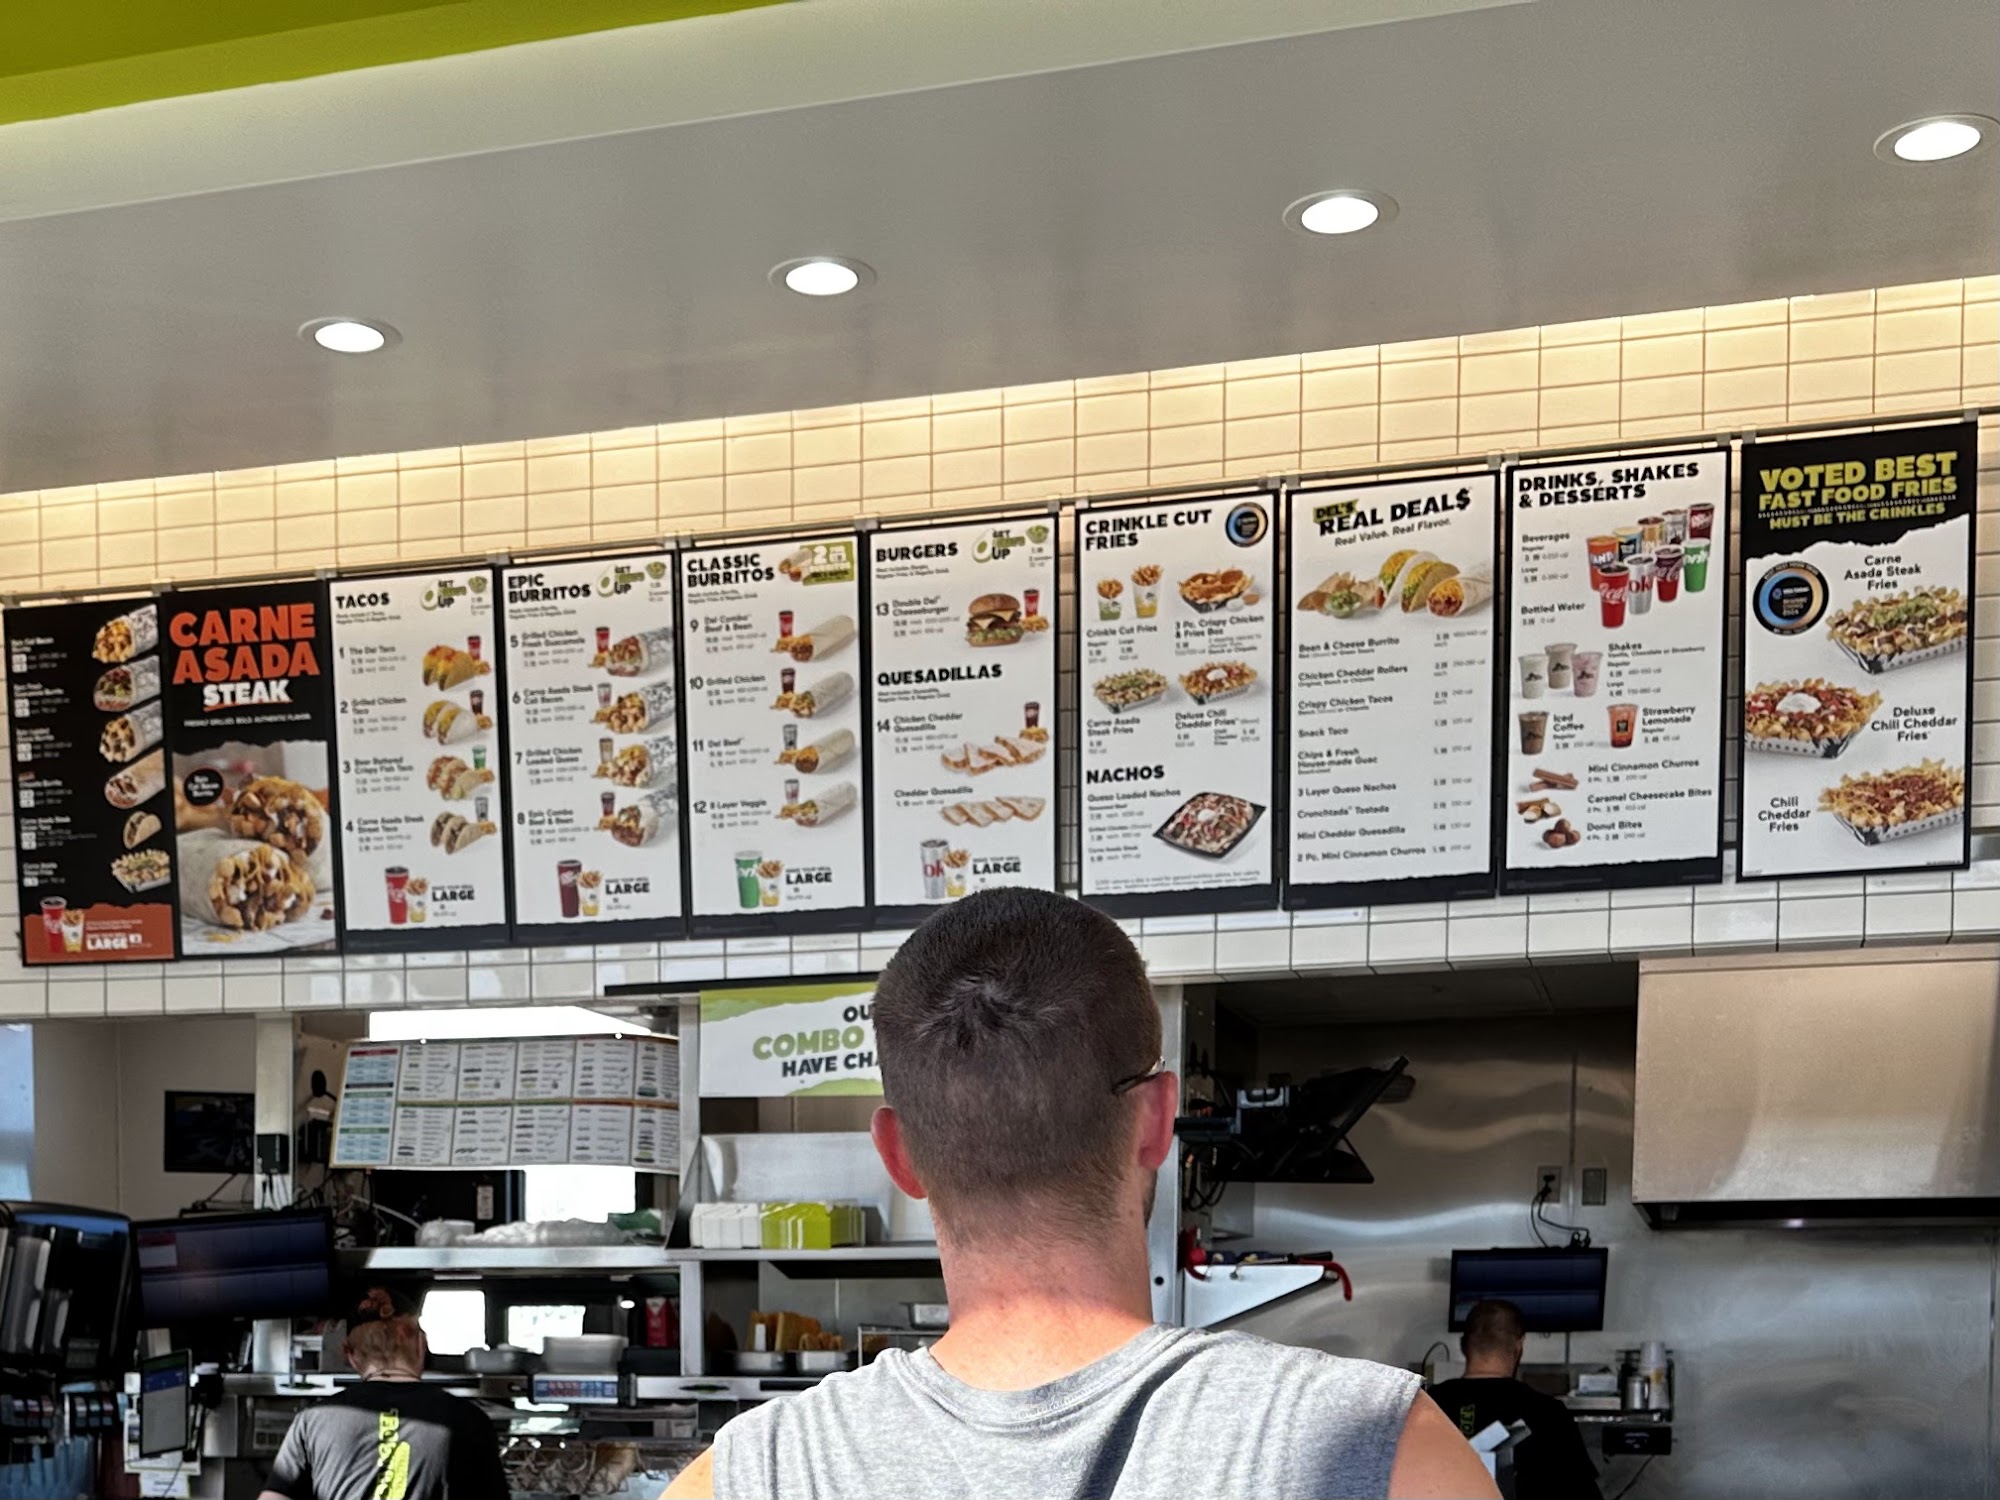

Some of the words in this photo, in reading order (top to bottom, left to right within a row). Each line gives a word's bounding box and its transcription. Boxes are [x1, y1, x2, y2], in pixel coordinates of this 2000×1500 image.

[1518, 470, 1604, 492] DRINKS,
[1611, 462, 1699, 484] SHAKES
[1760, 461, 1866, 492] VOTED
[1875, 451, 1958, 481] BEST
[1519, 493, 1533, 508] &
[1539, 484, 1646, 507] DESSERTS
[1759, 489, 1816, 512] FAST
[1821, 483, 1886, 505] FOOD
[1892, 476, 1958, 499] FRIES
[1316, 500, 1356, 519] DEL'S
[1320, 508, 1384, 536] REAL
[1390, 487, 1471, 521] DEAL$
[1770, 514, 1811, 530] MUST
[1813, 512, 1834, 526] BE
[1837, 509, 1866, 523] THE
[1869, 502, 1946, 521] CRINKLES
[1085, 514, 1168, 535] CRINKLE
[1174, 509, 1212, 526] CUT
[1334, 537, 1357, 547] Real
[1359, 531, 1389, 542] Value.
[1392, 523, 1415, 535] Real
[1417, 518, 1451, 531] Flavor.
[1522, 532, 1570, 543] Beverages
[1086, 533, 1138, 551] FRIES
[813, 545, 828, 565] 2
[876, 542, 959, 562] BURGERS
[992, 547, 1010, 560] UP
[687, 554, 761, 572] CLASSIC
[1864, 555, 1902, 566] Carne
[688, 567, 775, 588] BURRITOS
[1844, 568, 1883, 581] Asada
[1886, 564, 1922, 576] Steak
[507, 574, 545, 589] EPIC
[1867, 579, 1898, 591] Fries
[508, 584, 592, 604] BURRITOS
[615, 584, 632, 595] UP
[336, 592, 390, 609] TACOS
[438, 597, 455, 608] UP
[876, 603, 889, 616] 13
[893, 597, 921, 607] Double
[893, 606, 949, 617] Cheeseburger
[1521, 604, 1555, 615] Bottled
[1557, 602, 1586, 612] Water
[169, 603, 316, 648] CARNE
[690, 620, 699, 632] 9
[1199, 619, 1227, 628] Crispy
[1230, 615, 1264, 625] Chicken
[510, 635, 519, 648] 5
[522, 632, 546, 641] Grilled
[548, 629, 578, 639] Chicken
[1087, 627, 1117, 638] Crinkle
[1119, 627, 1134, 635] Cut
[1137, 625, 1158, 634] Fries
[1184, 629, 1205, 638] Fries
[1208, 628, 1223, 636] Box
[339, 648, 345, 658] 1
[379, 646, 396, 654] Taco
[1299, 644, 1321, 653] Bean
[1332, 640, 1365, 650] Cheese
[1368, 637, 1399, 647] Burrito
[1608, 642, 1642, 651] Shakes
[173, 641, 320, 685] ASADA
[877, 664, 1002, 686] QUESADILLAS
[1298, 672, 1334, 681] Chicken
[1336, 668, 1374, 678] Cheddar
[1377, 665, 1408, 674] Rollers
[690, 676, 704, 690] 10
[706, 676, 732, 686] Grilled
[734, 675, 766, 684] Chicken
[203, 679, 292, 706] STEAK
[512, 692, 521, 705] 6
[340, 702, 348, 713] 2
[378, 697, 406, 705] Chicken
[1298, 701, 1327, 710] Crispy
[1329, 698, 1365, 707] Chicken
[1368, 695, 1393, 704] Tacos
[1175, 711, 1204, 721] Deluxe
[1553, 713, 1573, 722] Iced
[1642, 706, 1696, 716] Strawberry
[1893, 706, 1935, 717] Deluxe
[877, 719, 890, 733] 14
[893, 715, 925, 724] Chicken
[928, 713, 963, 722] Cheddar
[894, 723, 936, 733] Quesadilla
[1087, 719, 1112, 728] Carne
[1115, 717, 1140, 725] Asada
[1175, 720, 1212, 730] Cheddar
[1553, 723, 1584, 732] Coffee
[1642, 716, 1692, 726] Lemonade
[1871, 719, 1901, 731] Chili
[1904, 716, 1958, 729] Cheddar
[1113, 727, 1133, 735] Fries
[1298, 728, 1325, 737] Snack
[1328, 727, 1349, 735] Taco
[1897, 730, 1928, 741] Fries
[692, 739, 704, 752] 11
[708, 740, 721, 748] Del
[515, 752, 523, 765] 7
[553, 747, 582, 755] Chicken
[1298, 750, 1324, 760] Chips
[1335, 748, 1359, 757] Fresh
[1355, 756, 1378, 764] Guac
[343, 761, 351, 773] 3
[526, 758, 553, 766] Loaded
[1588, 764, 1608, 773] Mini
[1611, 761, 1659, 772] Cinnamon
[1661, 759, 1699, 769] Churros
[1087, 765, 1165, 784] NACHOS
[894, 790, 929, 798] Cheddar
[931, 787, 973, 797] Quesadilla
[1088, 793, 1114, 802] Queso
[1116, 791, 1147, 800] Loaded
[1149, 788, 1181, 797] Nachos
[1305, 788, 1330, 797] Layer
[1332, 785, 1361, 794] Queso
[1363, 782, 1397, 792] Nachos
[1587, 793, 1626, 804] Caramel
[1629, 789, 1685, 801] Cheesecake
[1688, 788, 1712, 797] Bites
[693, 801, 707, 814] 12
[717, 801, 738, 811] Layer
[741, 799, 767, 809] Veggie
[1770, 796, 1799, 808] Chili
[517, 813, 526, 825] 8
[546, 808, 574, 816] Combo
[1355, 805, 1389, 814] Tostada
[1758, 810, 1811, 821] Cheddar
[346, 821, 353, 832] 4
[357, 818, 379, 826] Carne
[1587, 823, 1616, 831] Donut
[1618, 821, 1642, 830] Bites
[1769, 822, 1799, 832] Fries
[1297, 832, 1316, 840] Mini
[1318, 829, 1356, 839] Cheddar
[1358, 826, 1406, 837] Quesadilla
[1321, 851, 1340, 860] Mini
[1343, 849, 1388, 859] Cinnamon
[1390, 847, 1426, 856] Churros
[972, 862, 1021, 876] LARGE
[786, 872, 832, 885] LARGE
[432, 889, 475, 902] LARGE
[605, 882, 650, 895] LARGE
[87, 937, 129, 951] LARGE
[843, 1004, 873, 1023] OU
[752, 1025, 865, 1060] COMBO
[781, 1056, 838, 1078] HAVE
[843, 1051, 879, 1070] CH
